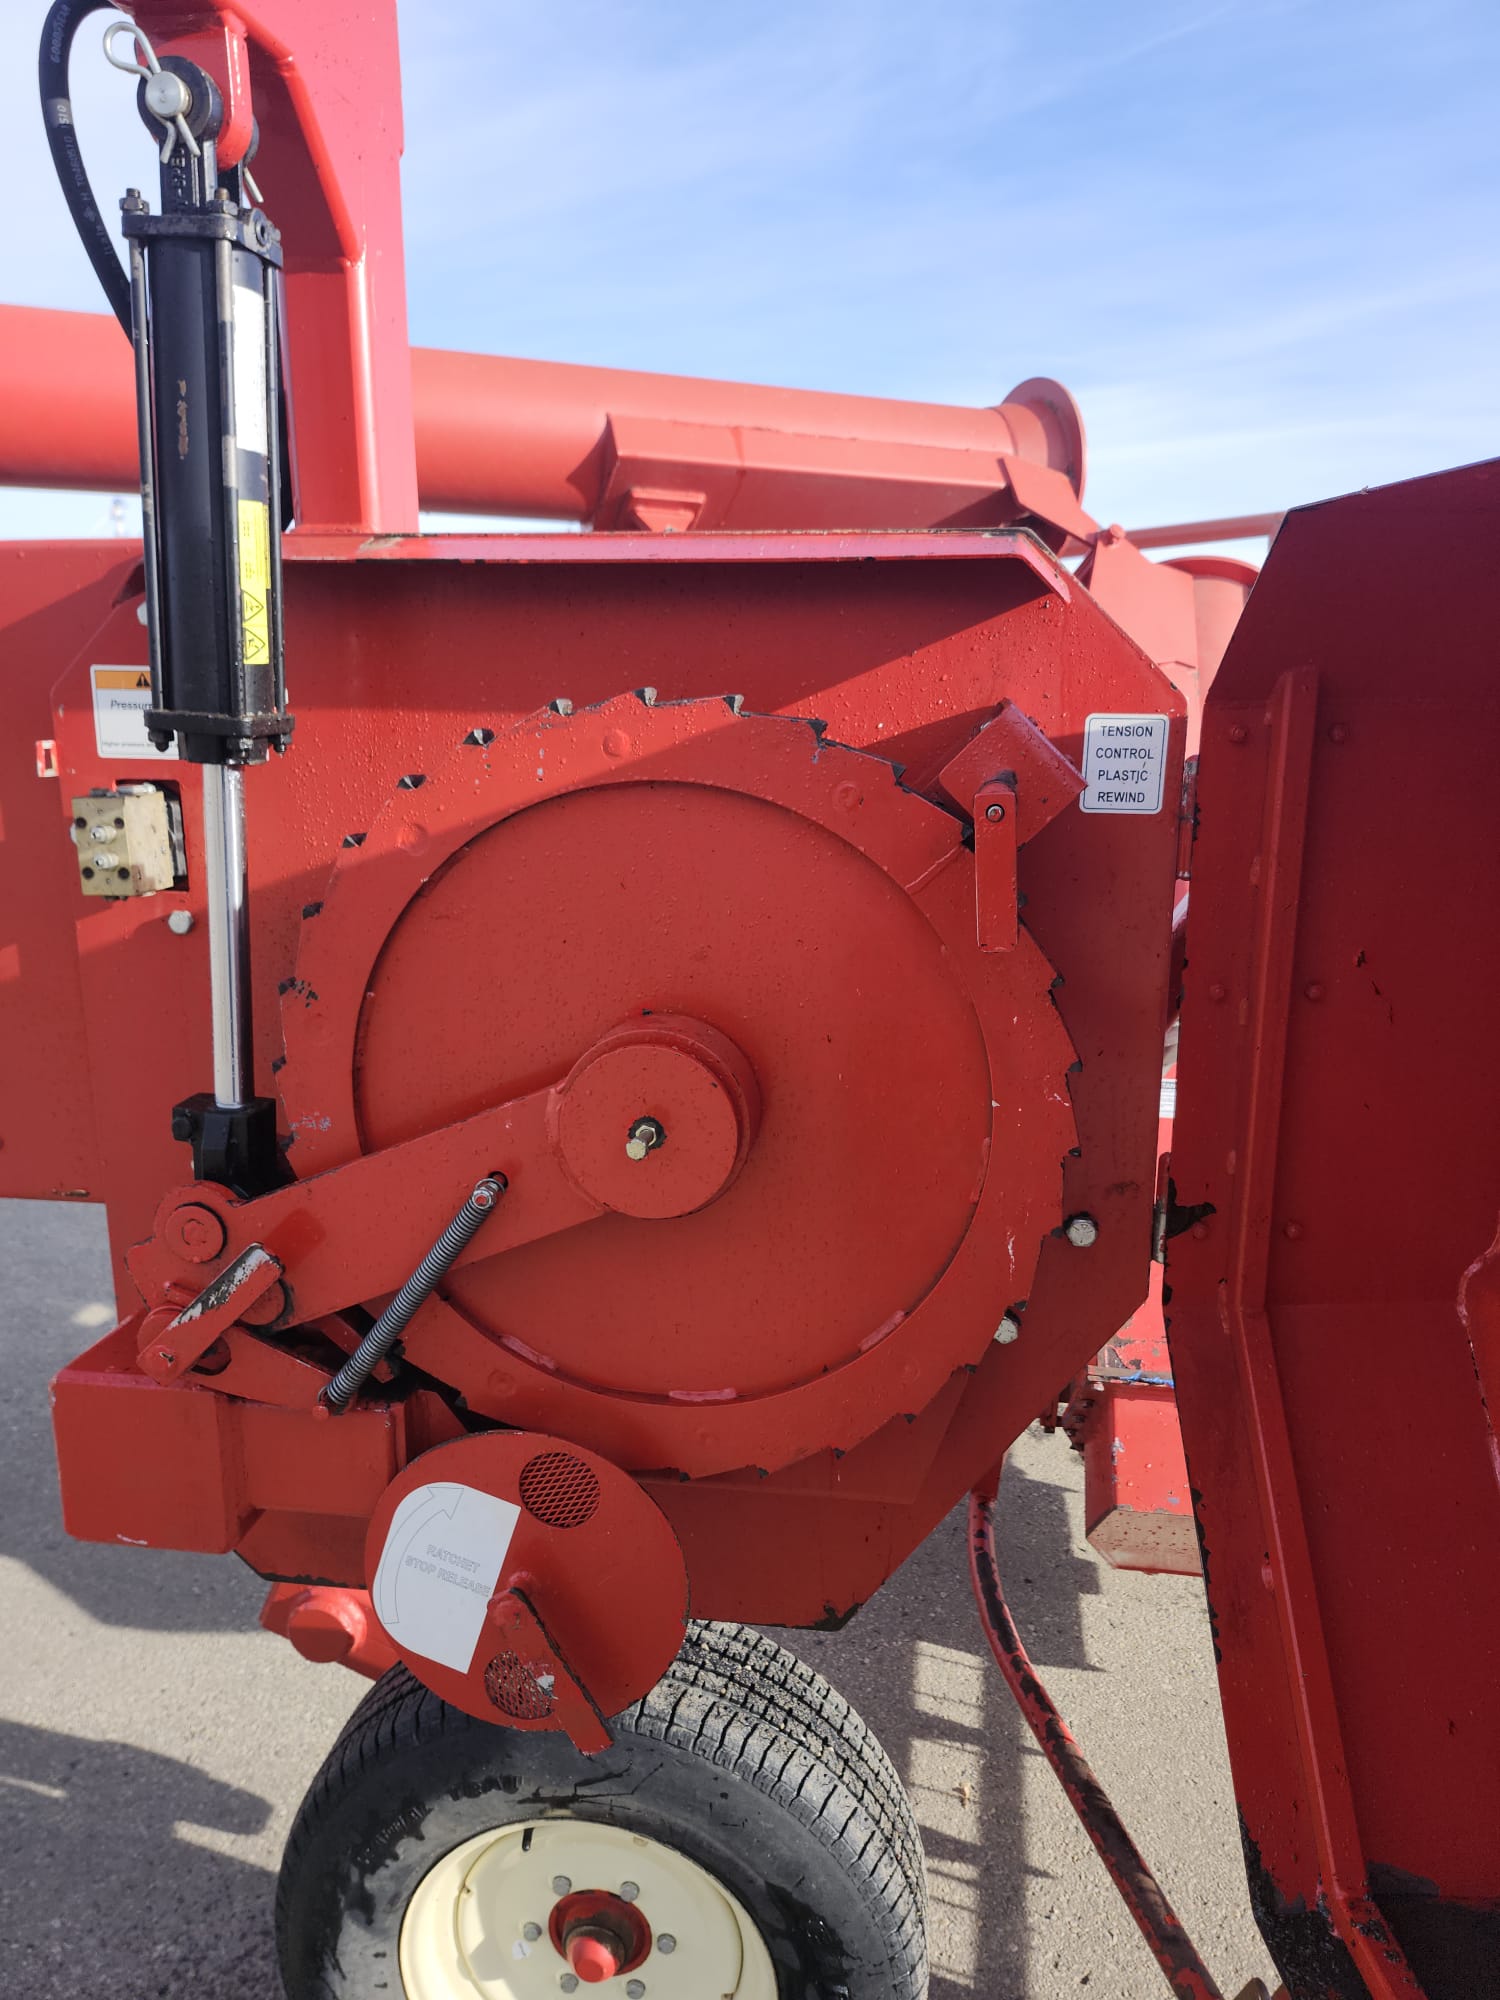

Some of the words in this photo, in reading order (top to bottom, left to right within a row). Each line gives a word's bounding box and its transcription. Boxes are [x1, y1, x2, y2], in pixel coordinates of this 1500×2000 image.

[1100, 725, 1153, 737] TENSION
[1095, 747, 1154, 760] CONTROL
[1098, 769, 1148, 781] PLASTIC
[1097, 791, 1145, 803] REWIND
[427, 1544, 480, 1573] RATCHET
[405, 1555, 437, 1574] STOP
[438, 1568, 491, 1597] RELEASE
